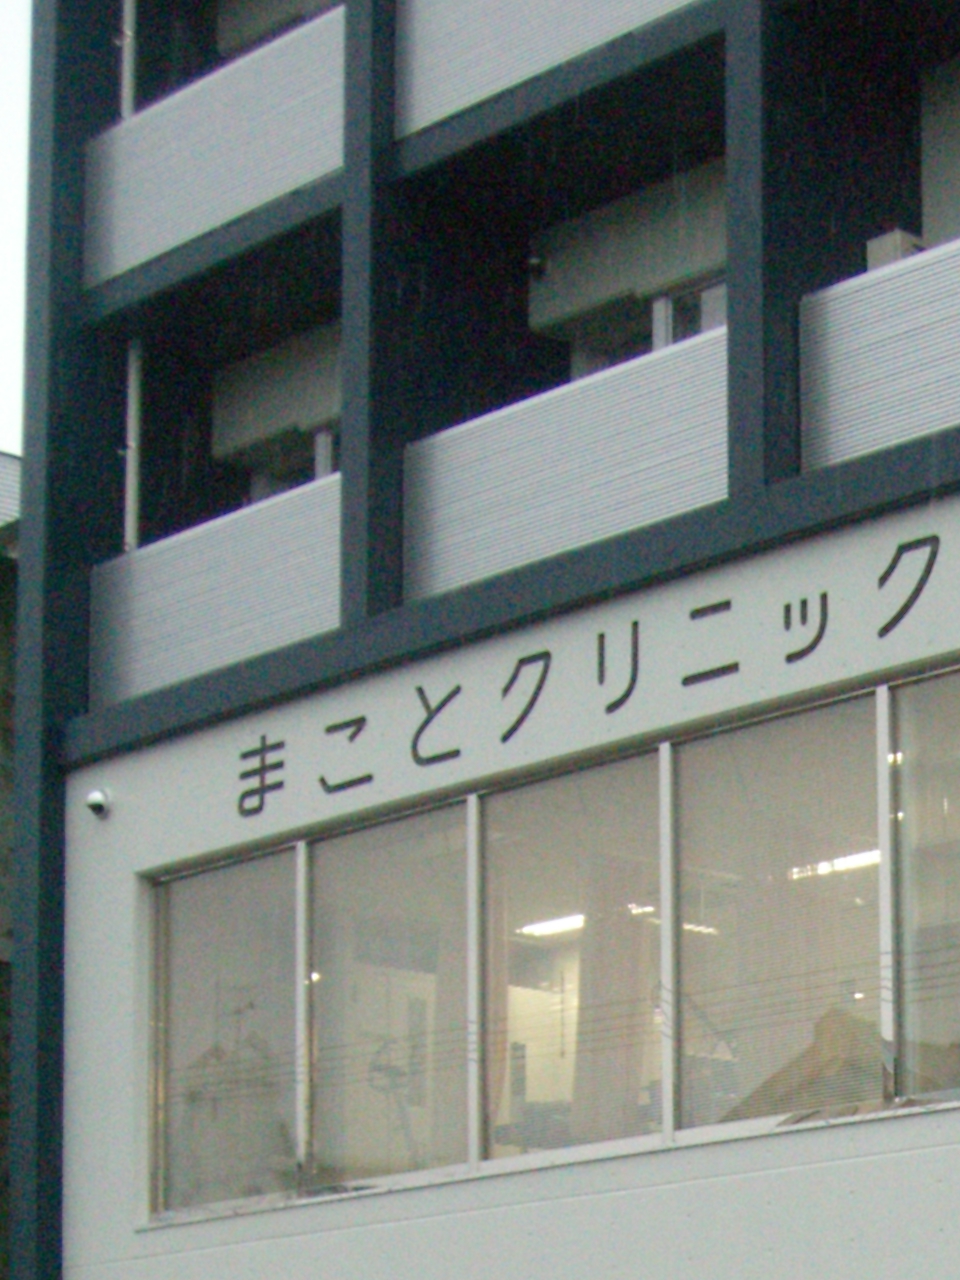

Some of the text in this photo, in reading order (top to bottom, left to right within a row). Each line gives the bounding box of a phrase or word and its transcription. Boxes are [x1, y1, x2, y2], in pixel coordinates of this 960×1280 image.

[237, 534, 940, 817] まことクリニック
